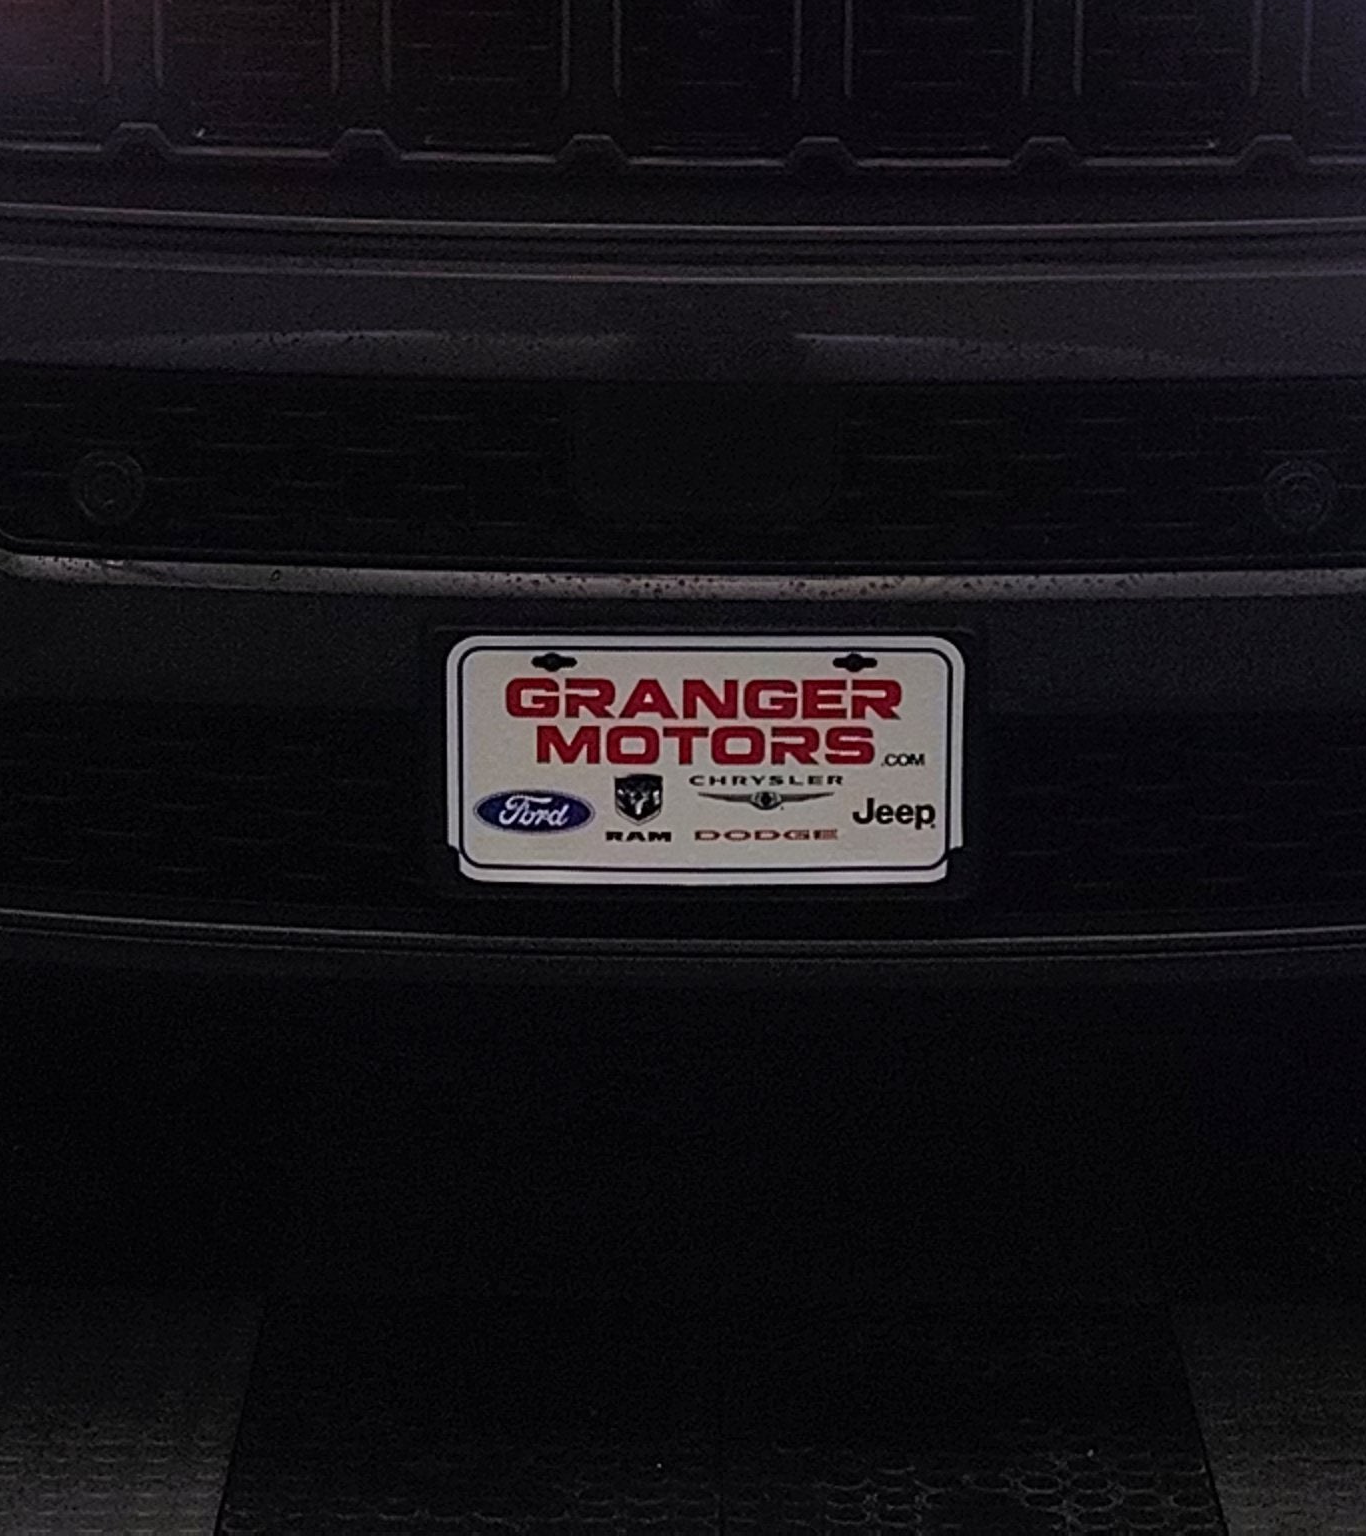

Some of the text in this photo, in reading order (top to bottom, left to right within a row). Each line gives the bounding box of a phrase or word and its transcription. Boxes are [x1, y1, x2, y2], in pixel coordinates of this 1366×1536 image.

[505, 677, 903, 720] GRANGER
[536, 725, 876, 766] MOTORS
[688, 774, 844, 786] CHRYSLER
[497, 794, 570, 829] Ford
[852, 798, 936, 829] Jeep
[605, 830, 672, 843] RAM
[693, 829, 839, 841] DODGE
